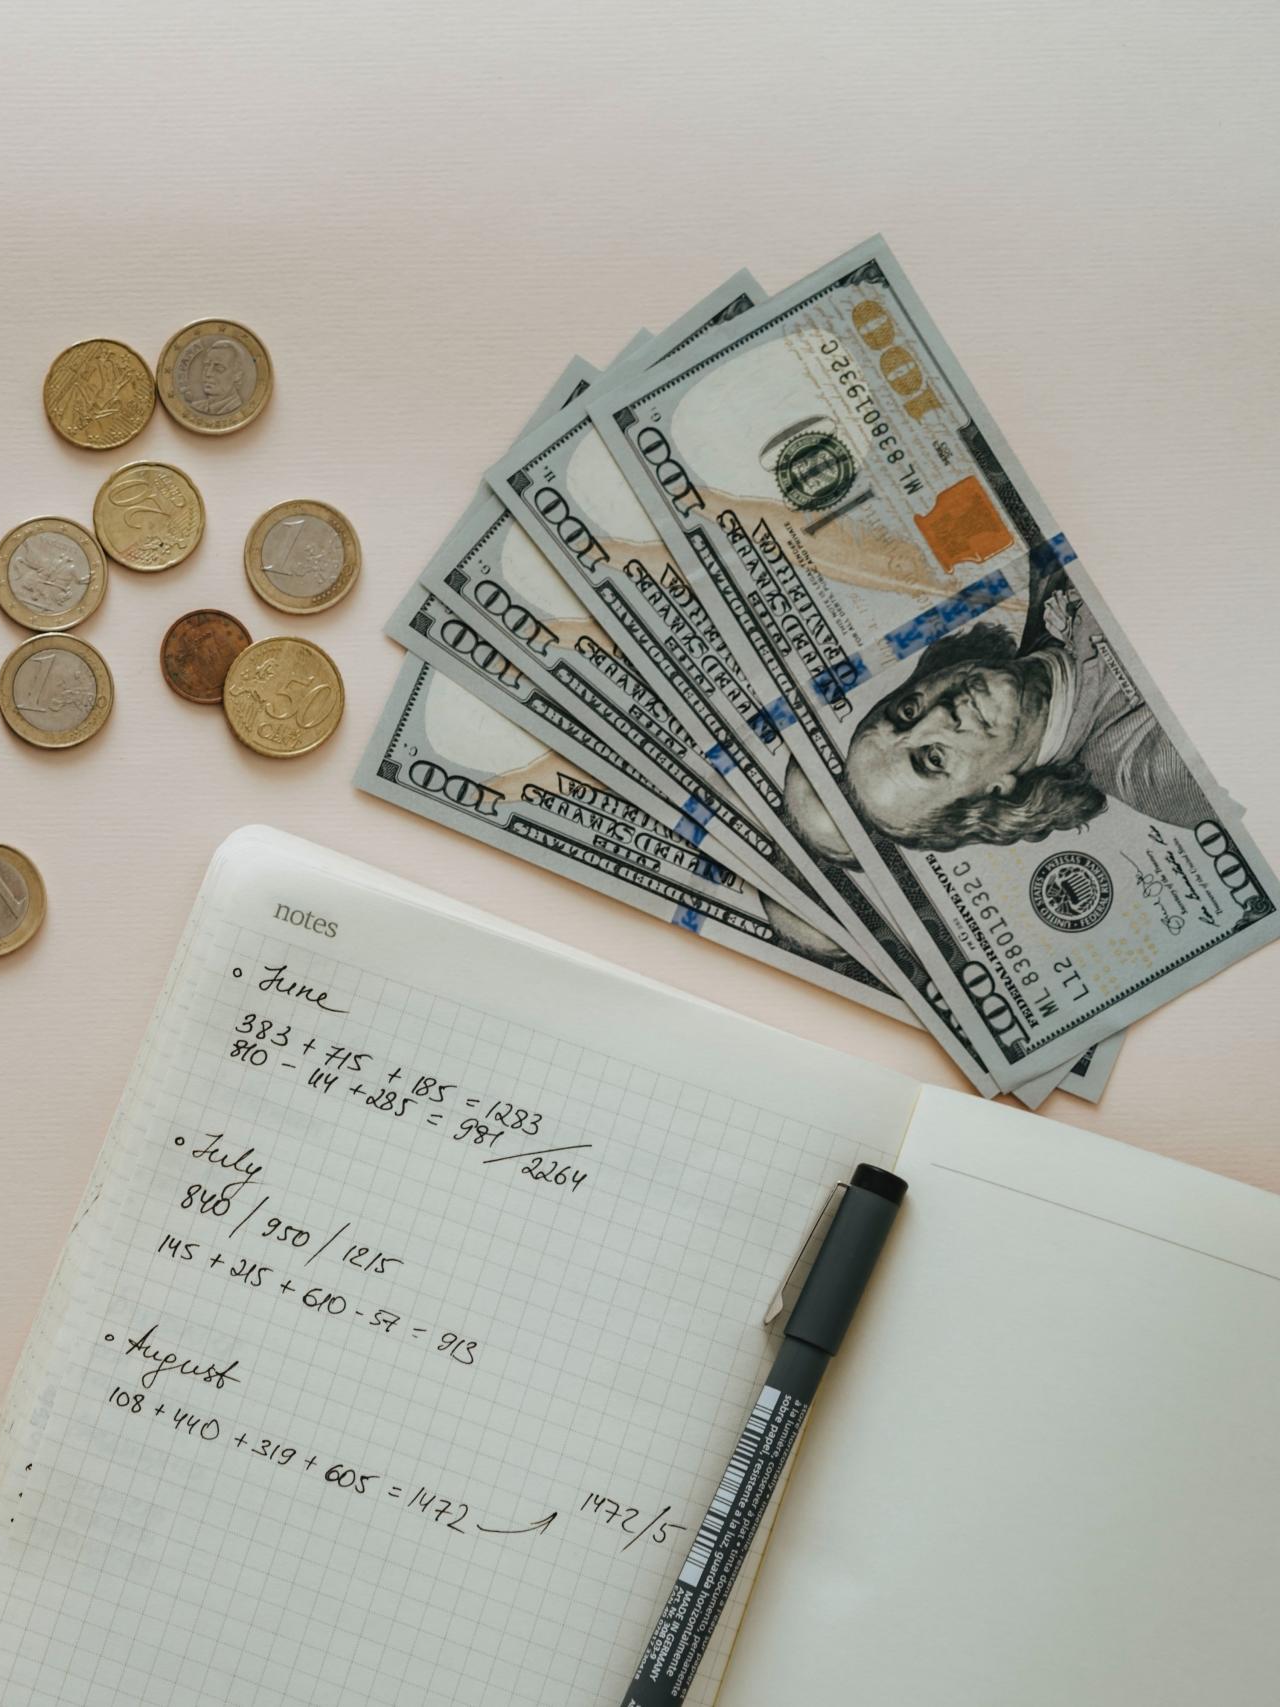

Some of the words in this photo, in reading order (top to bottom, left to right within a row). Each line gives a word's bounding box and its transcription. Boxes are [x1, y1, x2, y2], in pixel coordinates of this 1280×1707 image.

[818, 336, 841, 357] C
[850, 298, 942, 421] 100
[829, 352, 906, 467] 83801932
[636, 426, 706, 519] 100
[894, 462, 924, 496] ML
[533, 485, 611, 573] 100
[689, 529, 759, 636] DOLLARS
[714, 506, 792, 620] STATES
[745, 515, 838, 653] AMERICA
[473, 578, 560, 656] 100
[750, 631, 817, 733] HUNDRED
[778, 609, 856, 723] UNITED
[1097, 641, 1136, 692] FRANKLIN
[265, 675, 332, 731] 50
[408, 759, 507, 817] 100
[924, 851, 957, 895] NOTE
[949, 858, 972, 879] C
[1194, 819, 1265, 912] 100
[274, 903, 340, 939] notes
[949, 891, 997, 960] RESERVE
[961, 875, 1040, 989] 83801932
[259, 965, 350, 1014] June
[956, 954, 1032, 1055] 100
[989, 954, 1040, 1030] FEDERAL
[1029, 985, 1060, 1019] ML
[1051, 954, 1091, 1002] L12
[230, 1040, 269, 1067] 810
[366, 1089, 418, 1117] 285
[453, 1118, 505, 1149] 981
[235, 1014, 292, 1047] 383
[325, 1046, 374, 1072] 715
[411, 1076, 458, 1103] 185
[485, 1101, 543, 1136] 1283
[192, 1134, 263, 1197] July
[522, 1157, 588, 1193] 2264
[181, 1184, 231, 1218] 840
[262, 1218, 312, 1248] 950
[342, 1245, 405, 1274] 1215
[158, 1234, 201, 1261] 145
[230, 1259, 274, 1288] 215
[302, 1288, 347, 1315] 610
[369, 1310, 401, 1333] 57
[437, 1333, 478, 1366] 913
[125, 1325, 241, 1390] August
[774, 1394, 792, 1424] sobre
[788, 1407, 798, 1418] la
[109, 1387, 146, 1414] 108
[174, 1408, 220, 1441] 440
[251, 1440, 297, 1466] 319
[325, 1464, 381, 1495] 605
[408, 1487, 470, 1535] 1472
[758, 1423, 780, 1457] papel,
[737, 1457, 765, 1509] resistente
[749, 1460, 776, 1509] conserver
[718, 1529, 735, 1550] luz,
[728, 1518, 740, 1530] la
[733, 1509, 742, 1517] a
[736, 1517, 752, 1540] plat
[701, 1549, 727, 1590] guarda
[722, 1548, 739, 1573] tinta
[665, 1605, 677, 1620] Nr.
[672, 1586, 685, 1605] Art.
[674, 1589, 694, 1621] MADE
[695, 1572, 728, 1635] documento,
[664, 1589, 709, 1678] horizontalmente
[669, 1620, 681, 1633] IN
[647, 1631, 676, 1683] GERMANY
[668, 1633, 703, 1698] permanente
